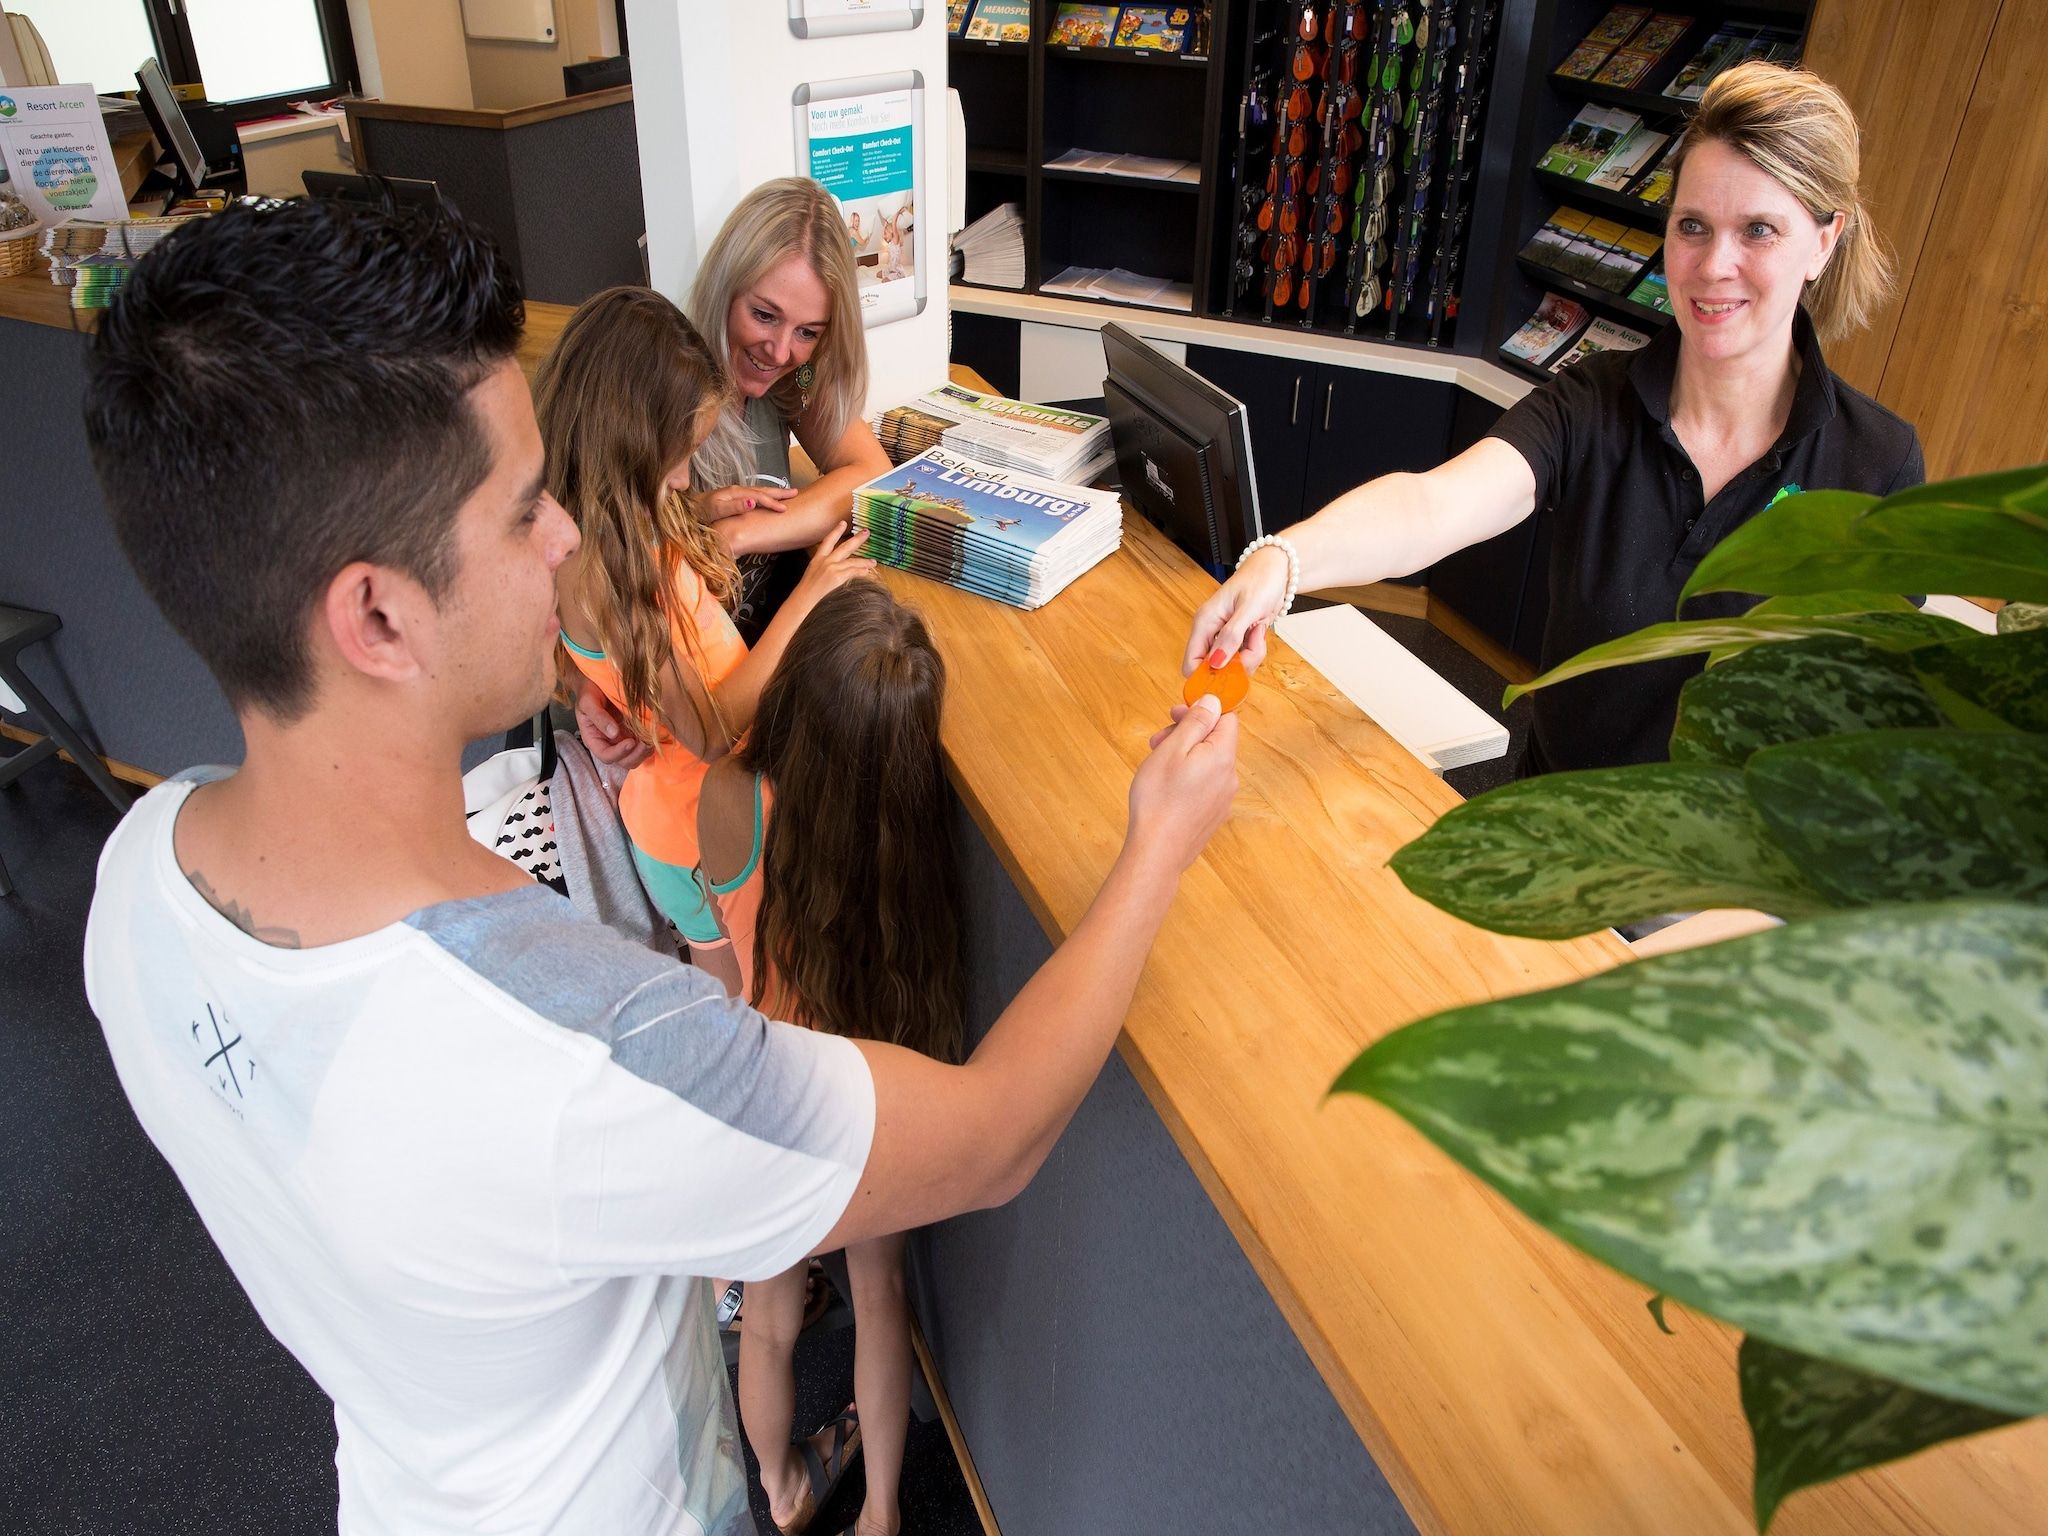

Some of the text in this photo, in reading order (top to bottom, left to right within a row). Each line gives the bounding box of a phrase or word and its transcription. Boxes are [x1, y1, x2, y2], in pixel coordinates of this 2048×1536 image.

[983, 5, 1029, 16] MEMOSPEL
[26, 100, 86, 111] Resort Arcen
[810, 104, 863, 120] Voor uw gemak!
[16, 147, 33, 156] Wilt
[52, 145, 85, 153] kinderen
[812, 145, 854, 158] Comfort Check-Out
[20, 159, 44, 167] dieren
[64, 156, 89, 164] voeren
[33, 165, 92, 177] de dierenweide?
[35, 180, 54, 188] Koop
[49, 188, 89, 198] voerzakjes!
[1593, 321, 1616, 335] Arcen
[1618, 330, 1642, 345] Arcen
[979, 399, 1092, 430] Vakantie
[924, 450, 1009, 483] Beleef!
[937, 468, 1076, 516] Limburg
